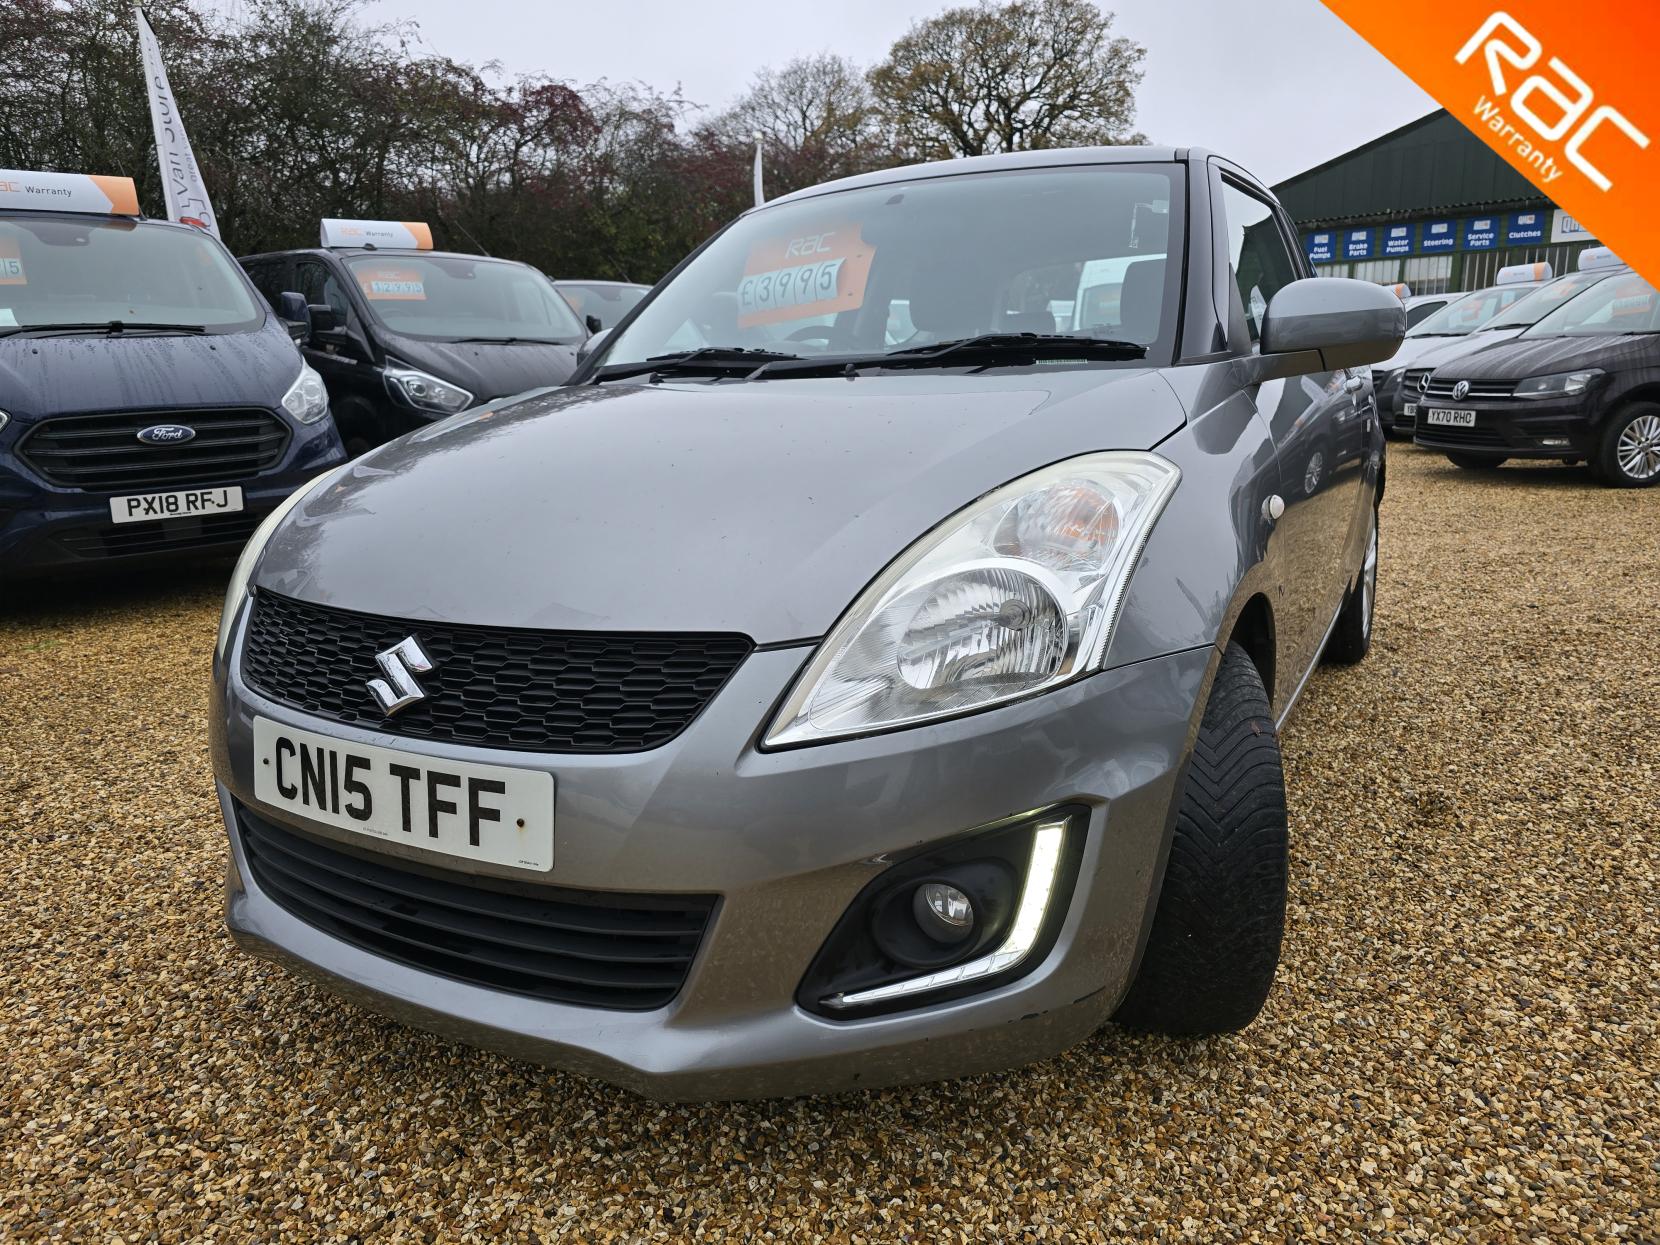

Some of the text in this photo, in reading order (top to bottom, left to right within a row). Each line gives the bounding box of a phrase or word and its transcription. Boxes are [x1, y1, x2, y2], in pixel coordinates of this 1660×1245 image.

[25, 185, 72, 197] Warranty
[365, 231, 394, 239] Warranty
[1467, 232, 1494, 240] Service
[1508, 231, 1541, 239] Clutches
[741, 263, 837, 306] £3995
[1431, 410, 1452, 423] YX70
[152, 427, 183, 440] Ford
[126, 490, 229, 517] PX18 RFJ
[275, 736, 506, 847] CN15 TFF
